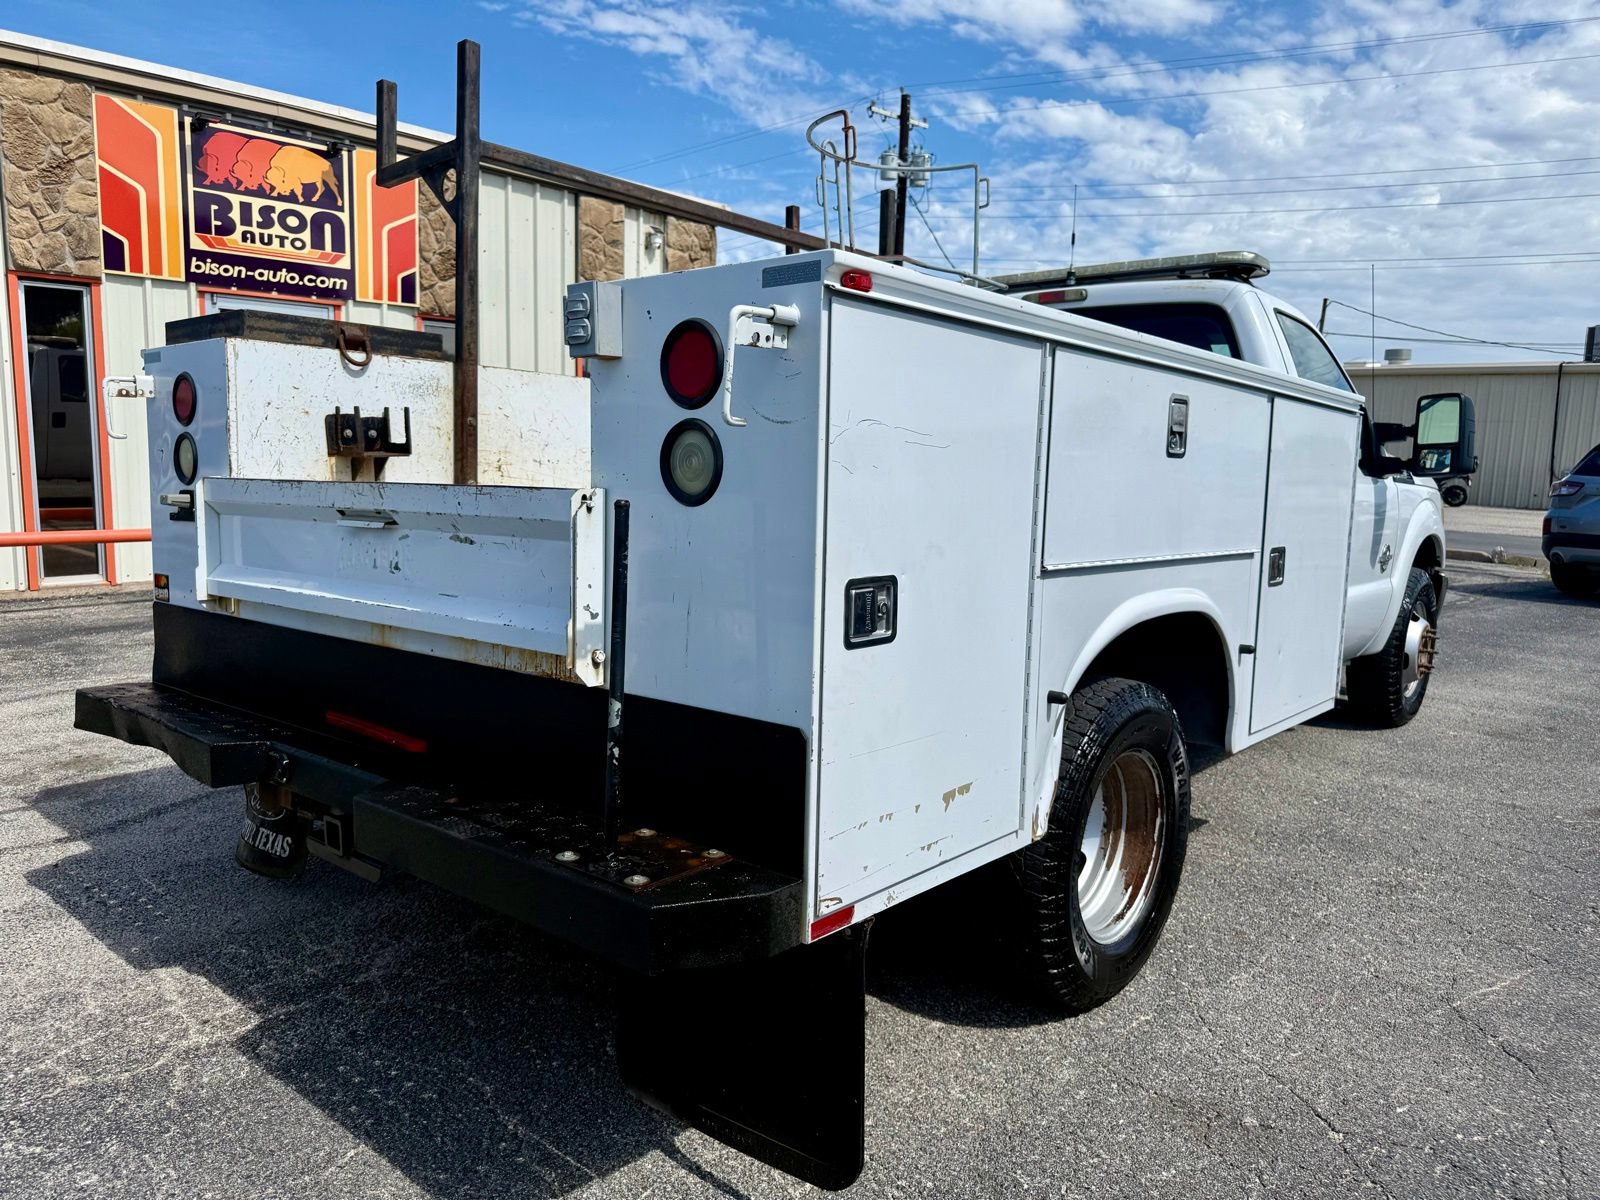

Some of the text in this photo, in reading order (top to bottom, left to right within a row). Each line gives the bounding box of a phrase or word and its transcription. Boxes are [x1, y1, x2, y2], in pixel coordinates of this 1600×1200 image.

[241, 229, 307, 252] AUTO
[190, 256, 348, 291] bison-auto.com
[254, 827, 293, 858] TEXAS
